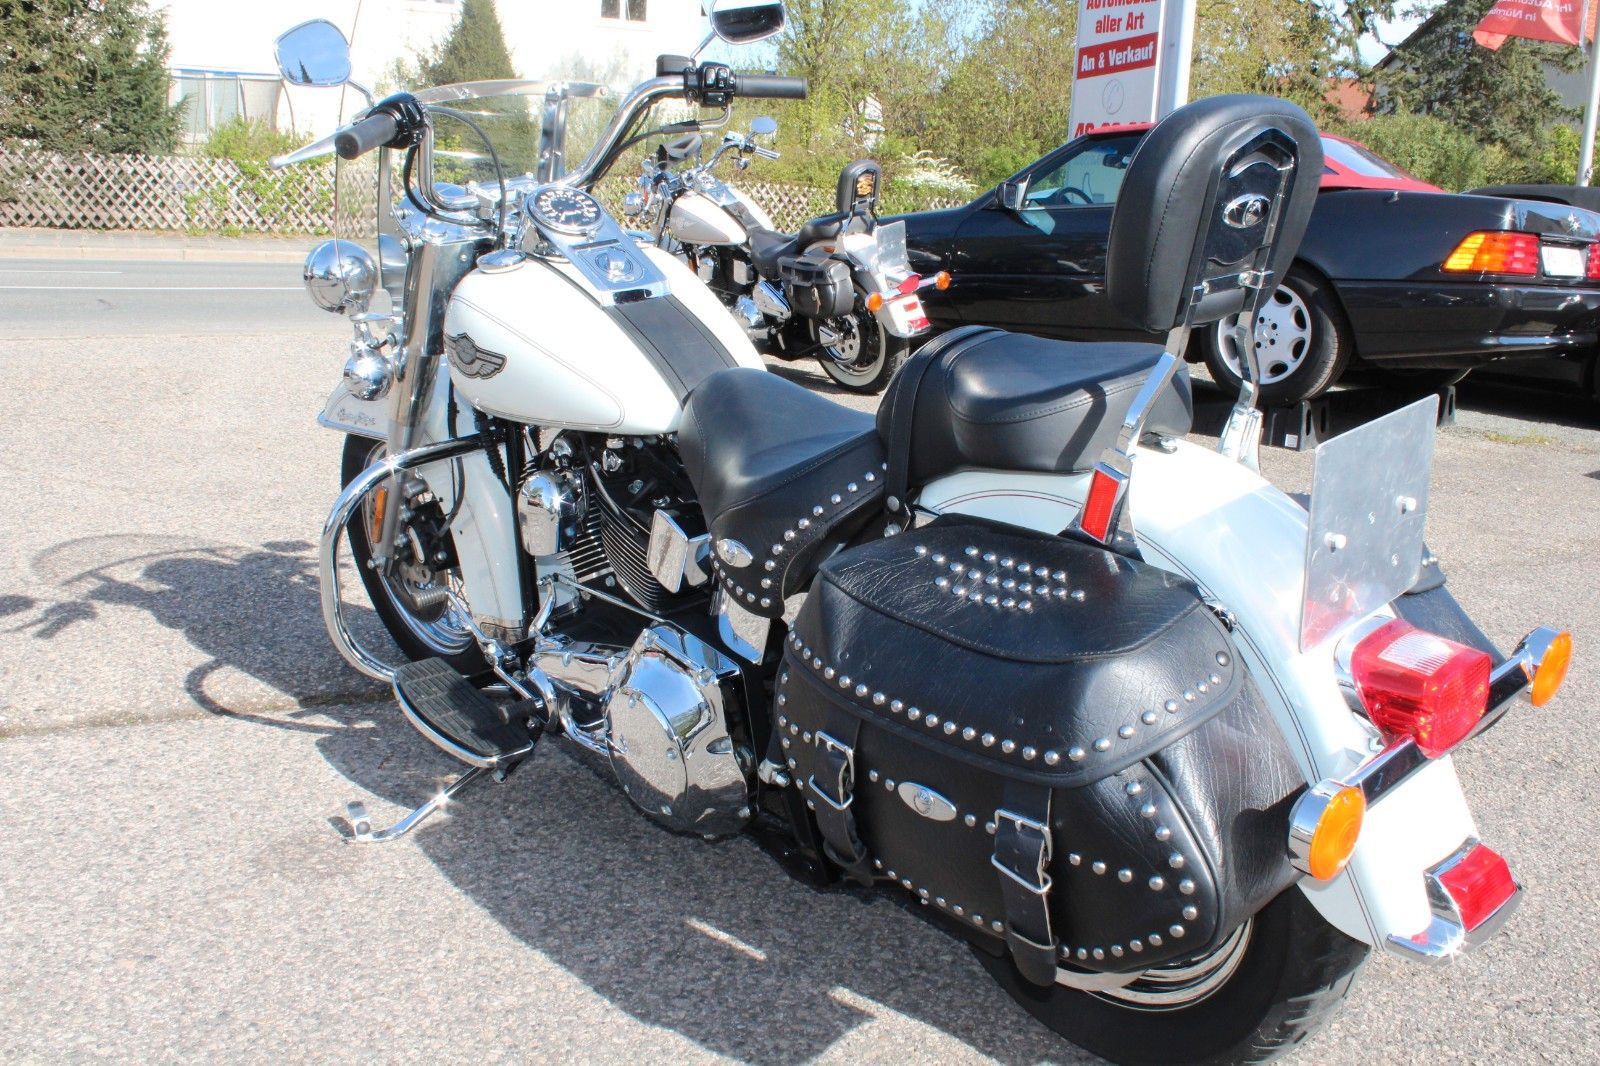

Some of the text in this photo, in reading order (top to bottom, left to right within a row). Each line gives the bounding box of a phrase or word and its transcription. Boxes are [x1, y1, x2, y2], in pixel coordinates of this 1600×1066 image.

[1095, 12, 1144, 34] aller Art
[1081, 41, 1154, 72] An & Verkauf
